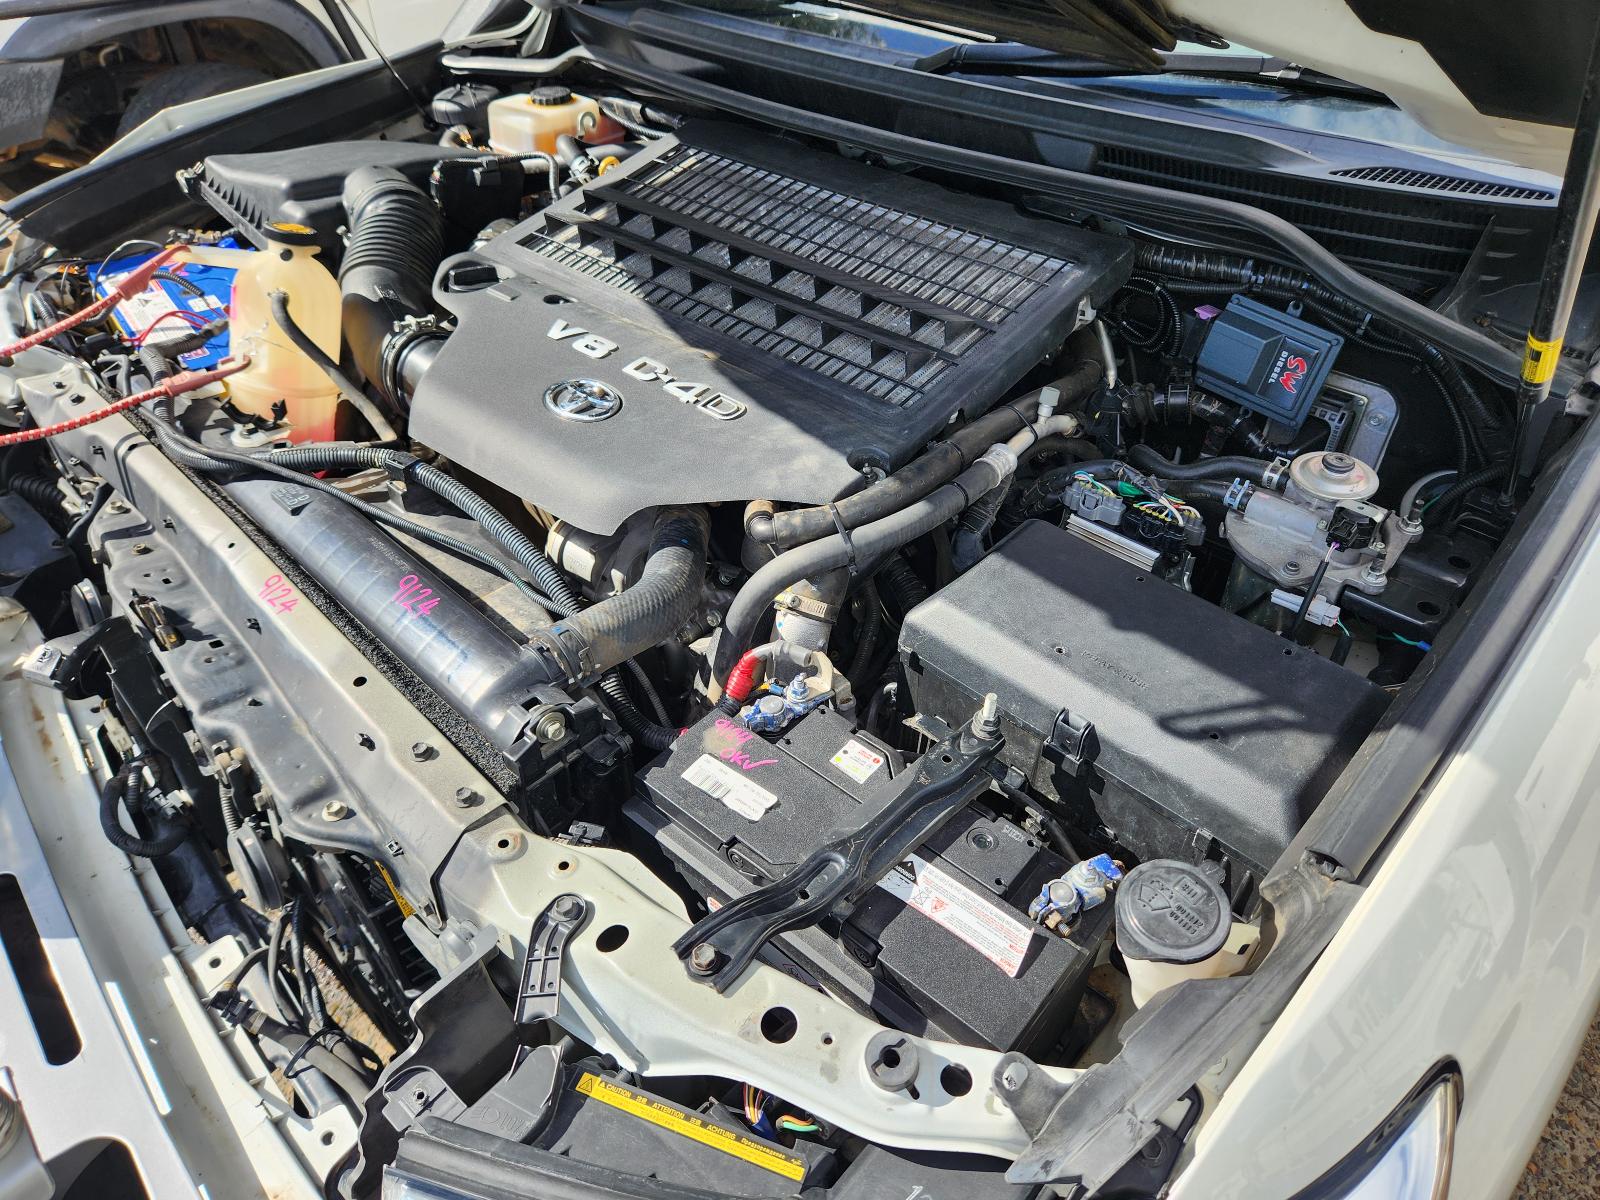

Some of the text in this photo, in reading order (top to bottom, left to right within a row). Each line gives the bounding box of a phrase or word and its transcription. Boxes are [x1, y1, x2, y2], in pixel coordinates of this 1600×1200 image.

[547, 318, 620, 360] V8
[1268, 350, 1289, 384] DIESEL
[1279, 355, 1307, 394] SW
[258, 574, 300, 616] 9124
[391, 575, 441, 620] 9124
[605, 1083, 632, 1099] CAUTION
[652, 1102, 685, 1120] ATTENTION
[706, 1124, 737, 1141] ACHTUNG
